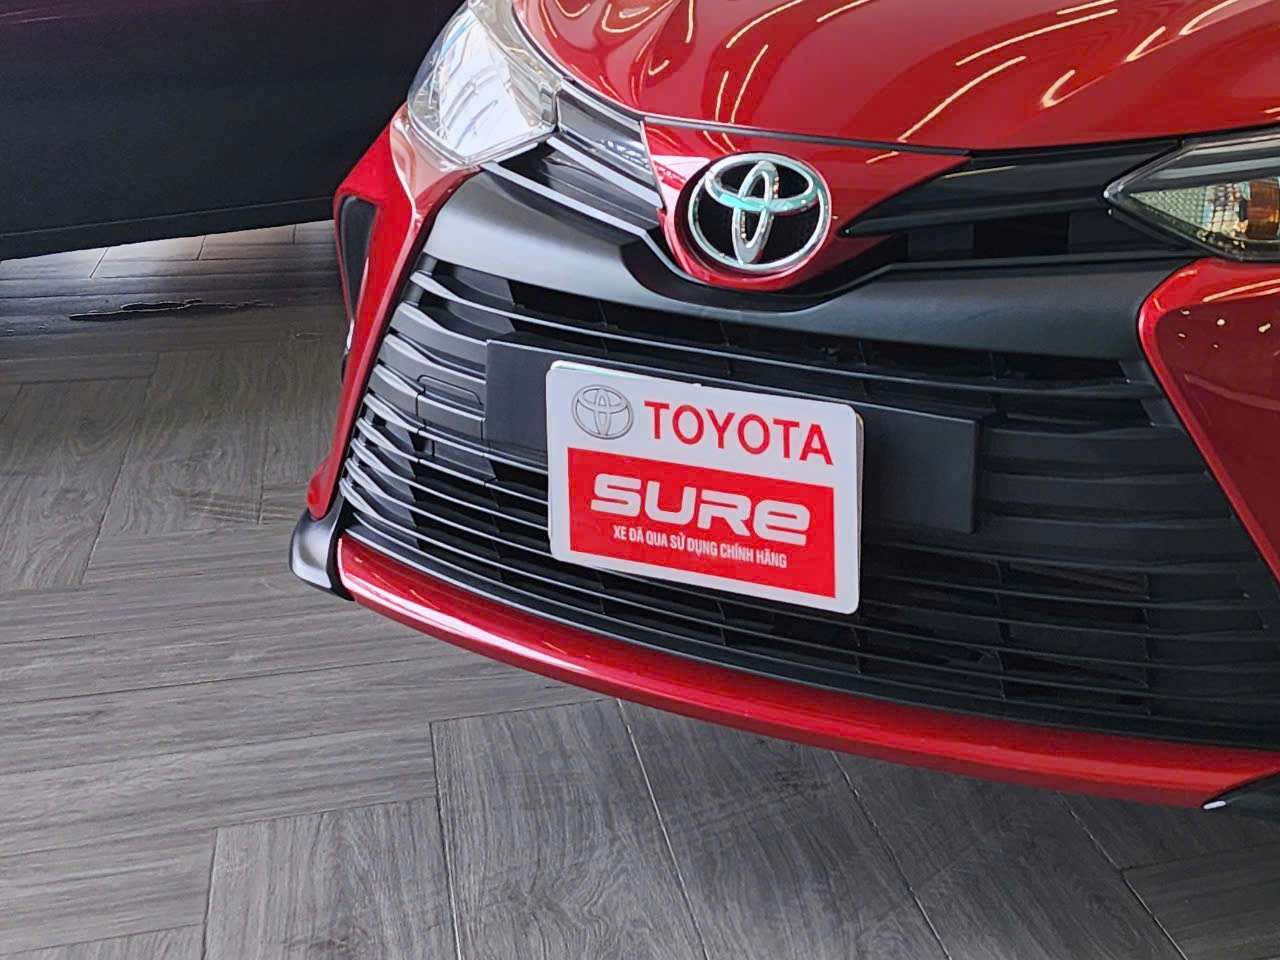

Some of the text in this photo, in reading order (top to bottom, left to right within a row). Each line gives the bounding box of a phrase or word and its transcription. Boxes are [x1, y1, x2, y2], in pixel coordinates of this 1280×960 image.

[643, 399, 835, 467] TOYOTA
[613, 524, 627, 541] XE
[645, 530, 668, 548] QUA
[687, 536, 718, 558] DỤNG
[719, 542, 754, 563] CHÍNH
